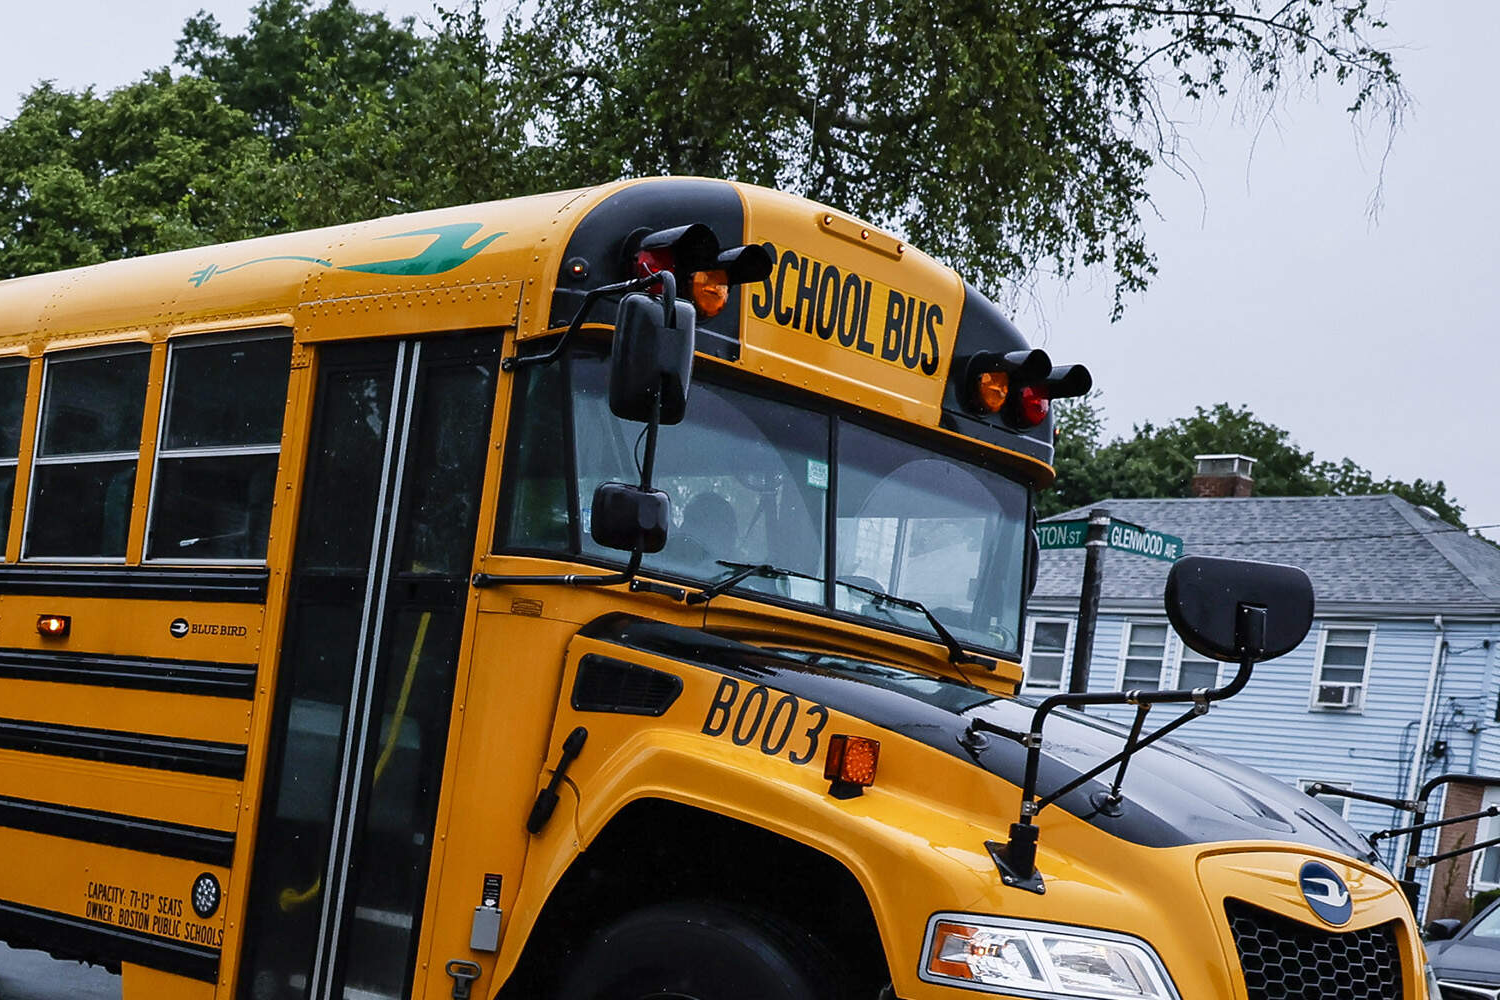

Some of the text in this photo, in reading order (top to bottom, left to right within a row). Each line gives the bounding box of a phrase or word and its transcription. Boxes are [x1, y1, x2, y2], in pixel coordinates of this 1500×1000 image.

[751, 242, 944, 376] SCHOOL BUS
[1037, 525, 1067, 545] TON
[1111, 526, 1177, 560] GLENWOOD AVE
[191, 624, 247, 637] BLUE BIRD
[701, 676, 829, 765] B003
[87, 881, 126, 906] CAPACITY:
[157, 896, 183, 917] SEATS
[85, 900, 224, 947] OWNER: BOSTON PUBLIC SCHOOLS
